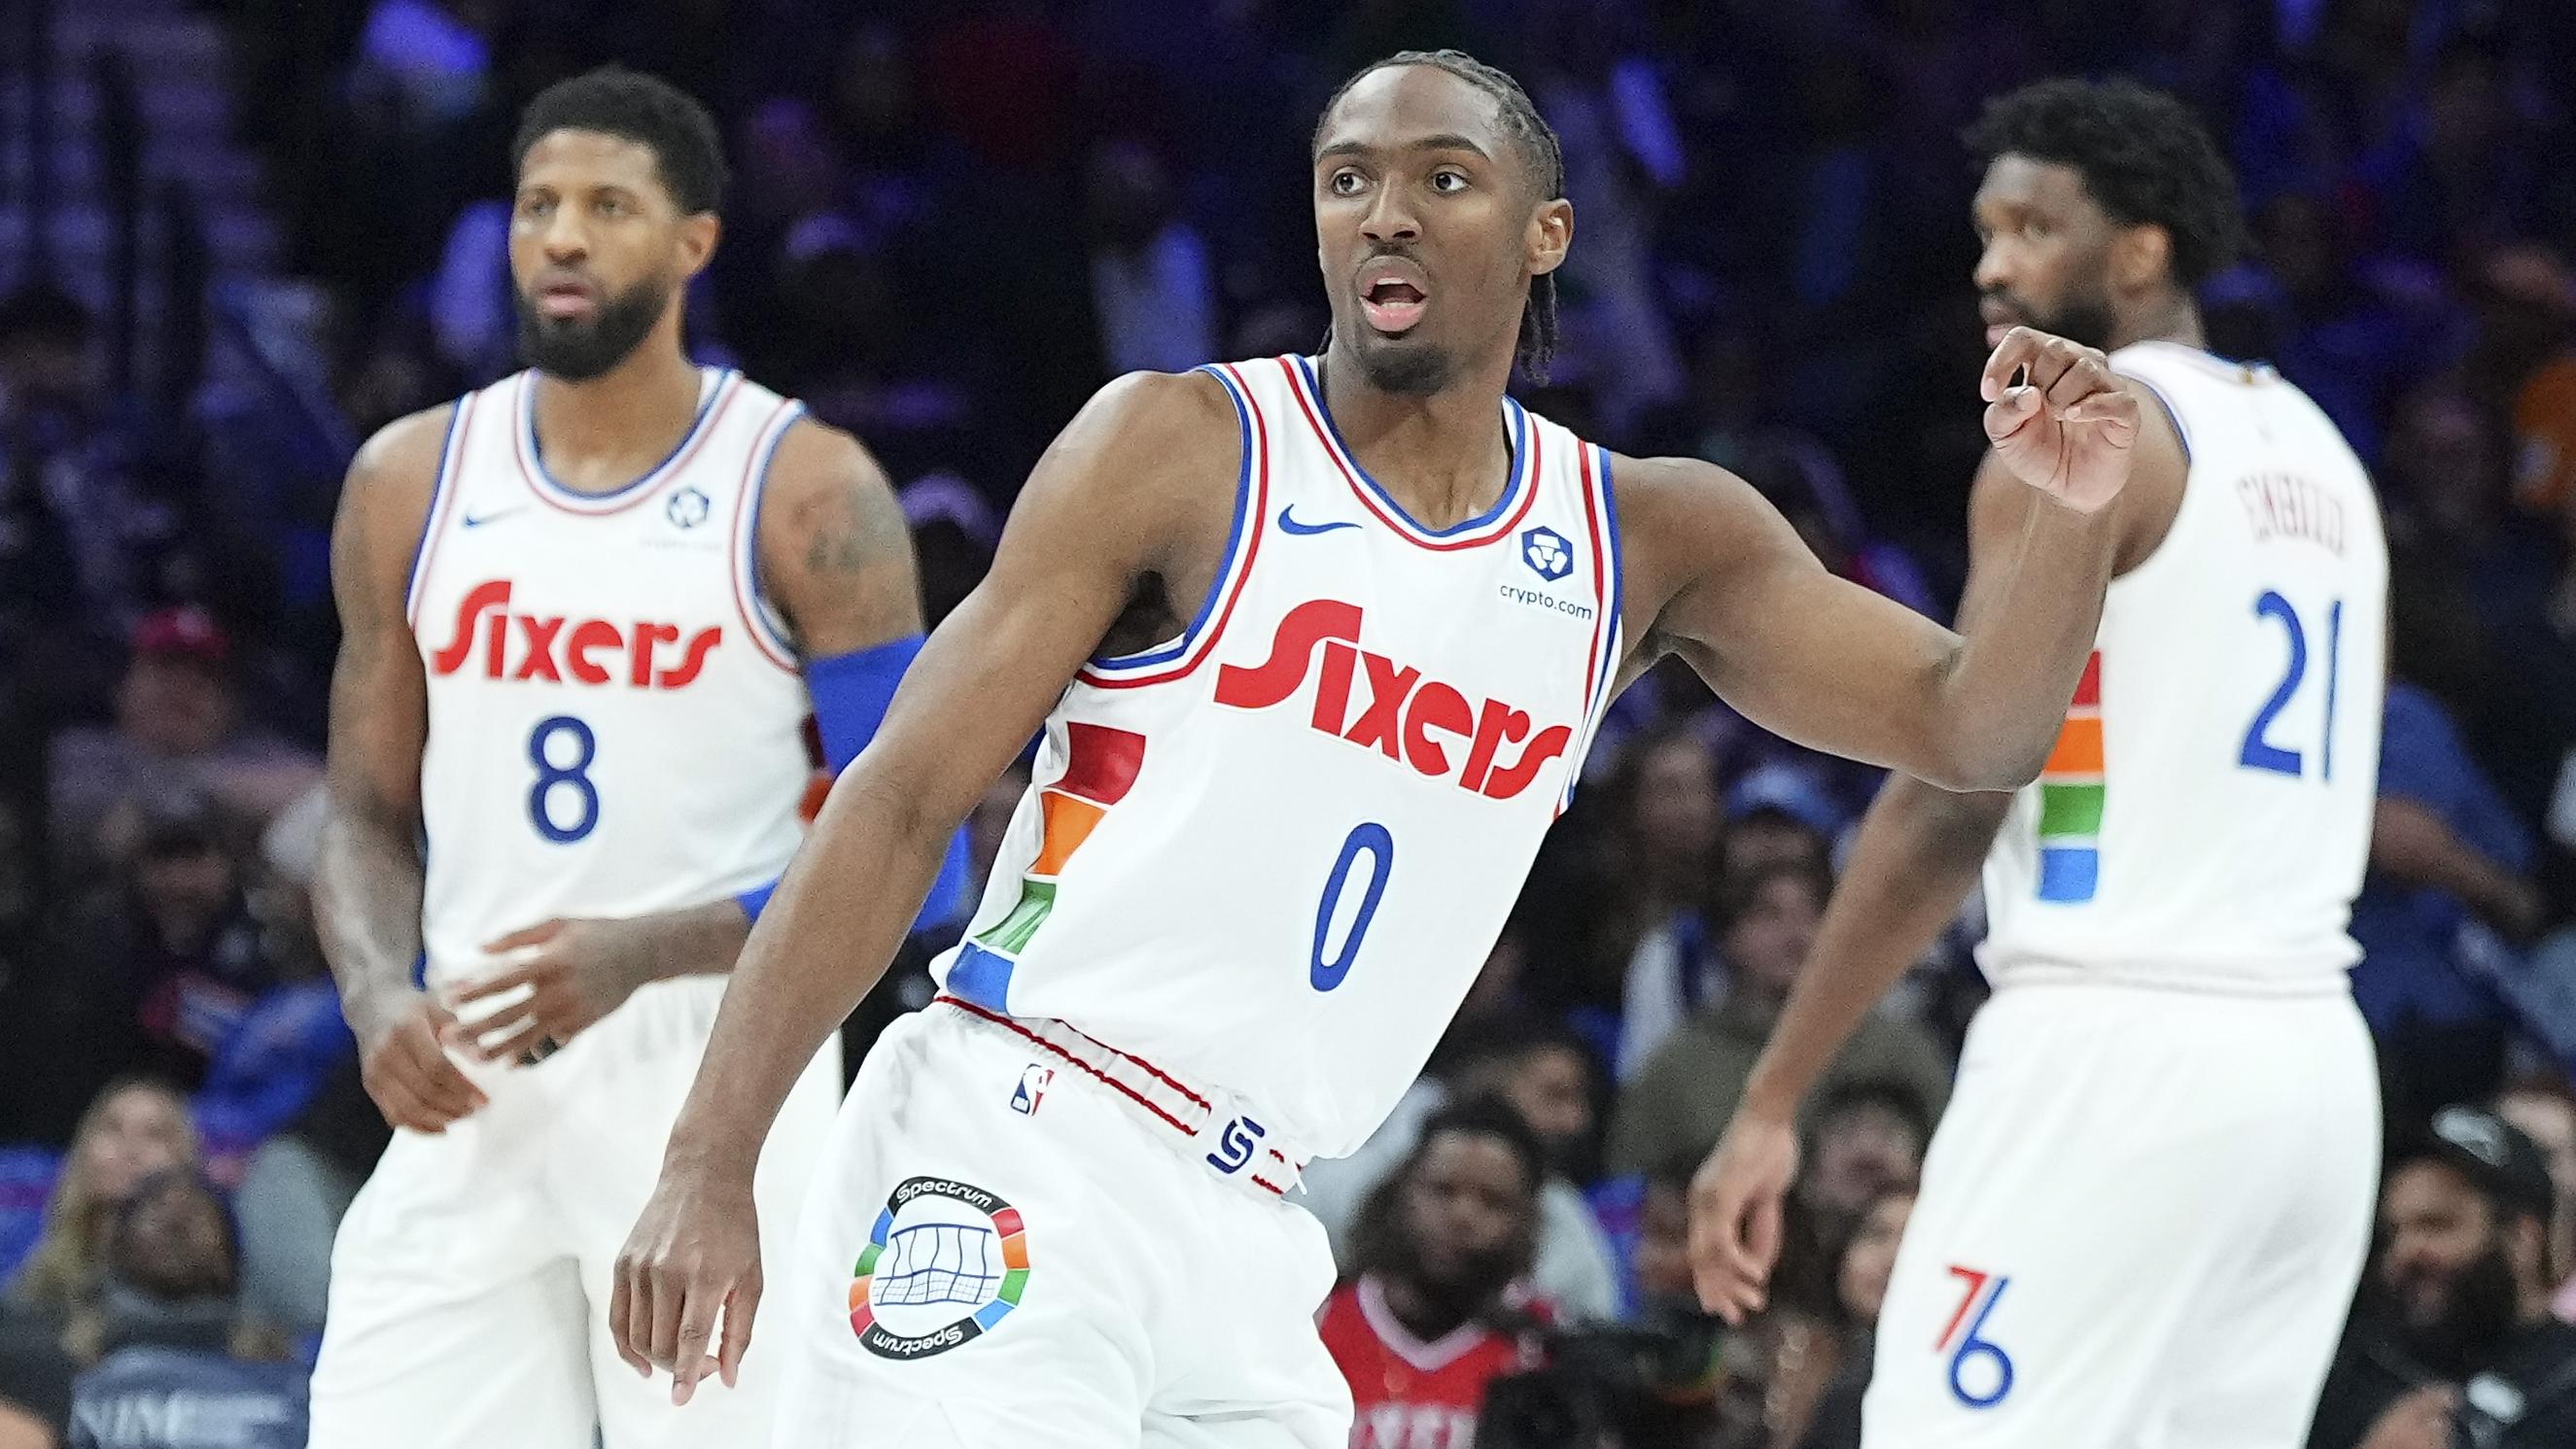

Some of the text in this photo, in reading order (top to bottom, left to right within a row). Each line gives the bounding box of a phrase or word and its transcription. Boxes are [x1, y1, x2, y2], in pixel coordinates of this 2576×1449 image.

[434, 580, 721, 689] Sixers
[1499, 585, 1592, 621] crypto.com
[1214, 599, 1572, 799] Sixers
[2241, 589, 2342, 780] 21
[529, 716, 599, 843] 8
[1310, 821, 1393, 992] 0
[896, 1180, 992, 1208] Spectrum
[873, 1326, 963, 1356] Spectrum
[1934, 1265, 2014, 1408] 76
